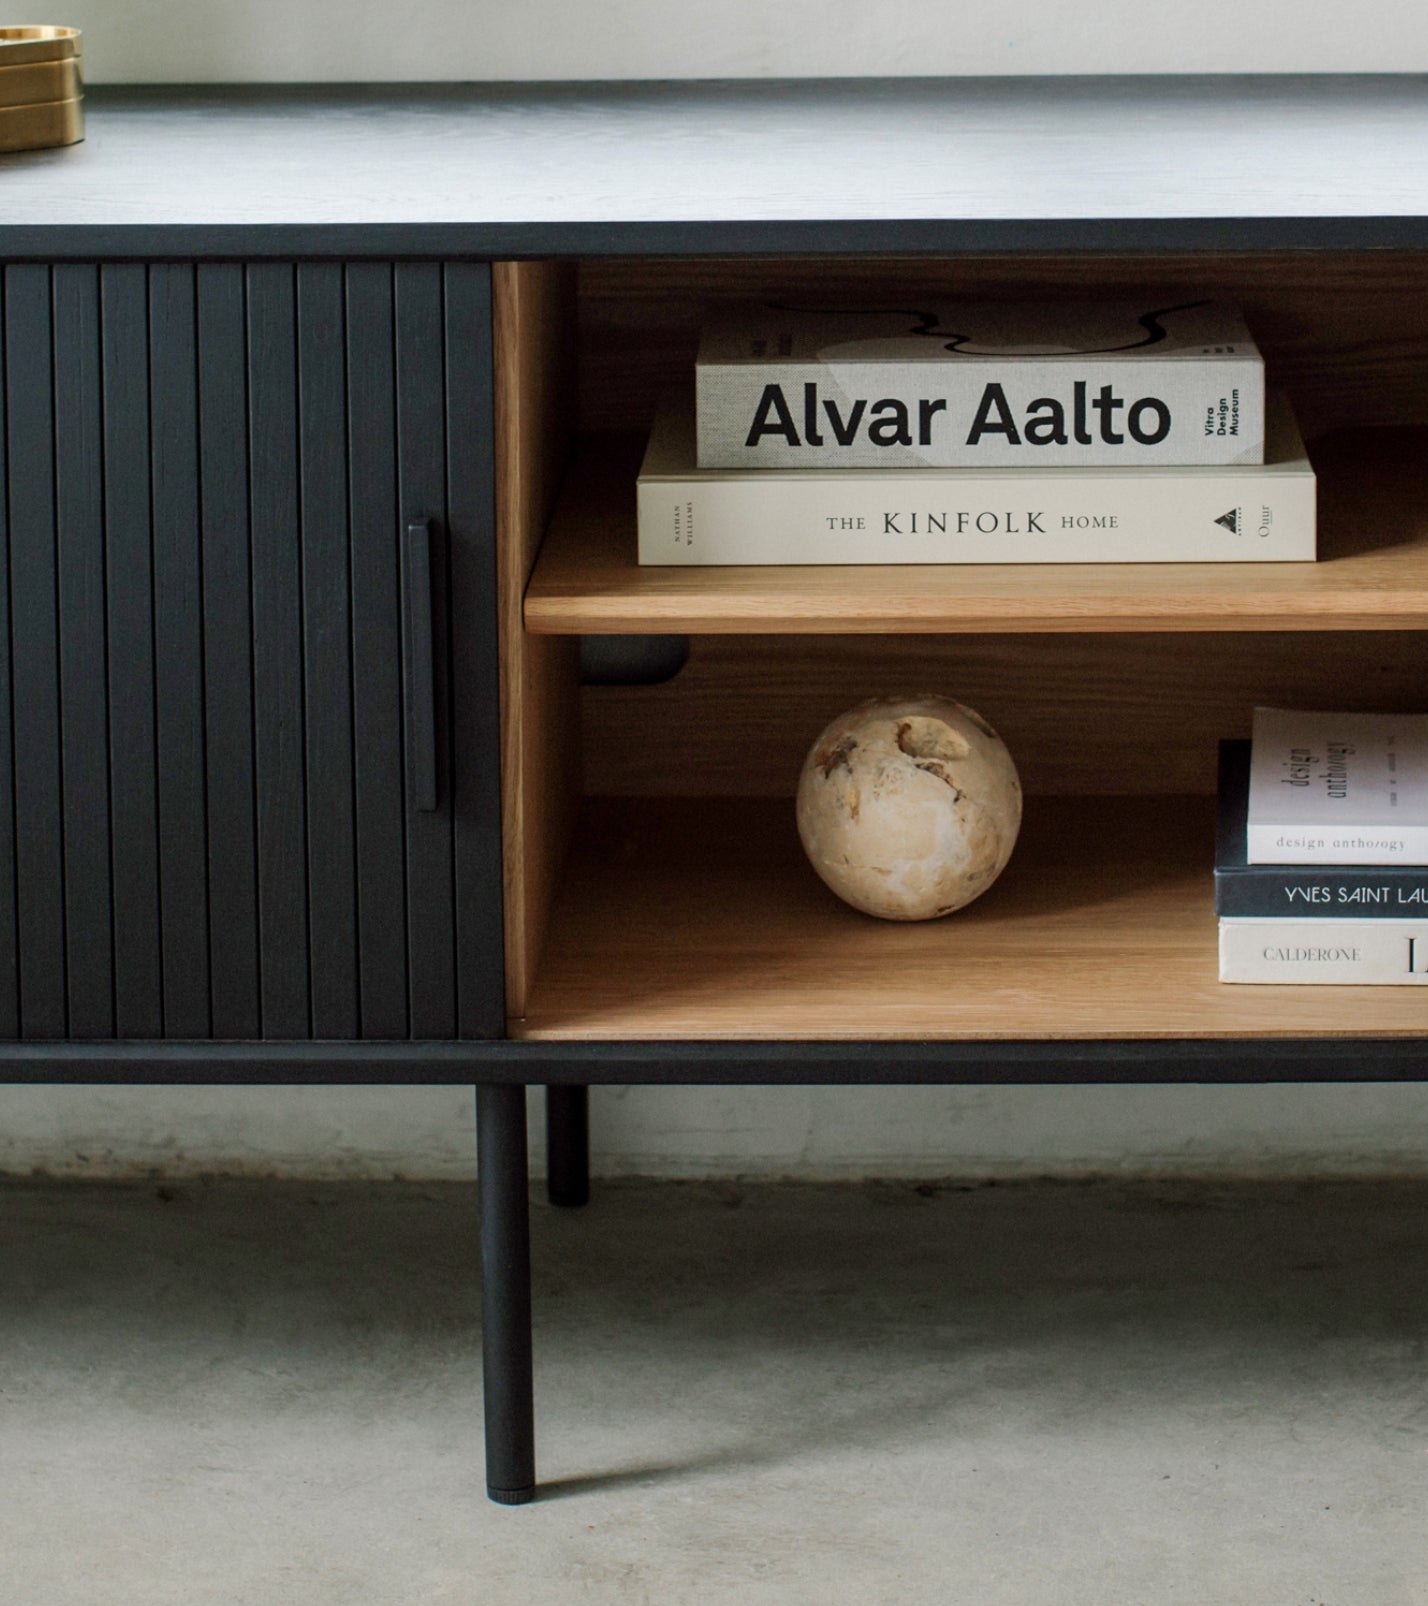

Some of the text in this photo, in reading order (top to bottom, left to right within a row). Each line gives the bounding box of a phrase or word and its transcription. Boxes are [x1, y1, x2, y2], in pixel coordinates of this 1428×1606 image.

[745, 381, 1171, 446] Alvar Aalto
[1204, 407, 1215, 436] Vitra
[1216, 397, 1229, 436] Design
[1229, 388, 1239, 436] Museum
[826, 512, 1119, 533] THE KINFOLK HOME
[1276, 837, 1407, 851] design anthology
[1284, 887, 1331, 903] YVES
[1338, 887, 1391, 903] SAINT
[1263, 948, 1361, 962] CALDERONE
